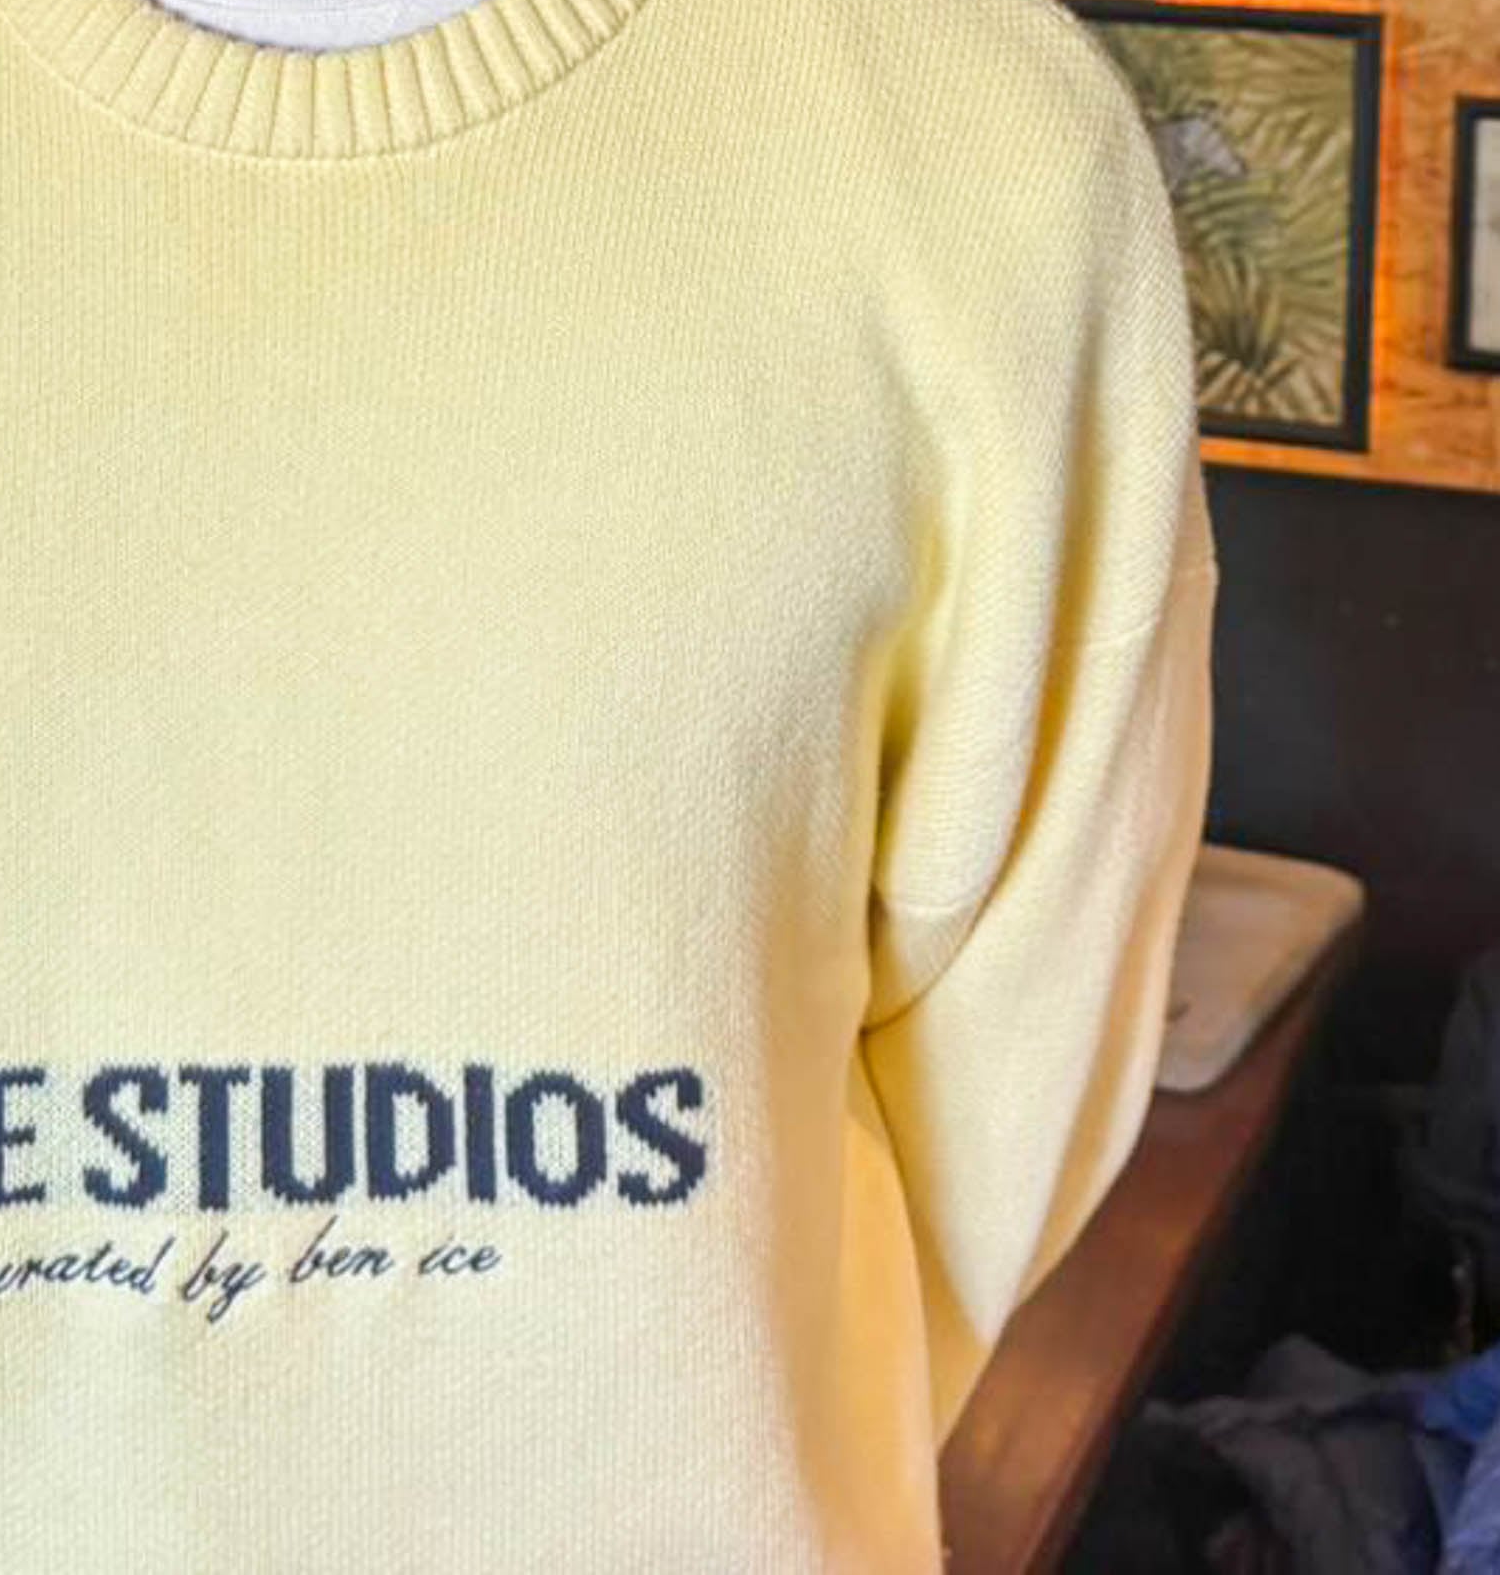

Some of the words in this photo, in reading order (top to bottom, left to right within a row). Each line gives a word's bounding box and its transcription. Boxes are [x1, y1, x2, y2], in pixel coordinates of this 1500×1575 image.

[83, 1062, 706, 1211] STUDIOS
[181, 1229, 267, 1324] by
[290, 1213, 395, 1284] ben
[418, 1234, 501, 1277] ice
